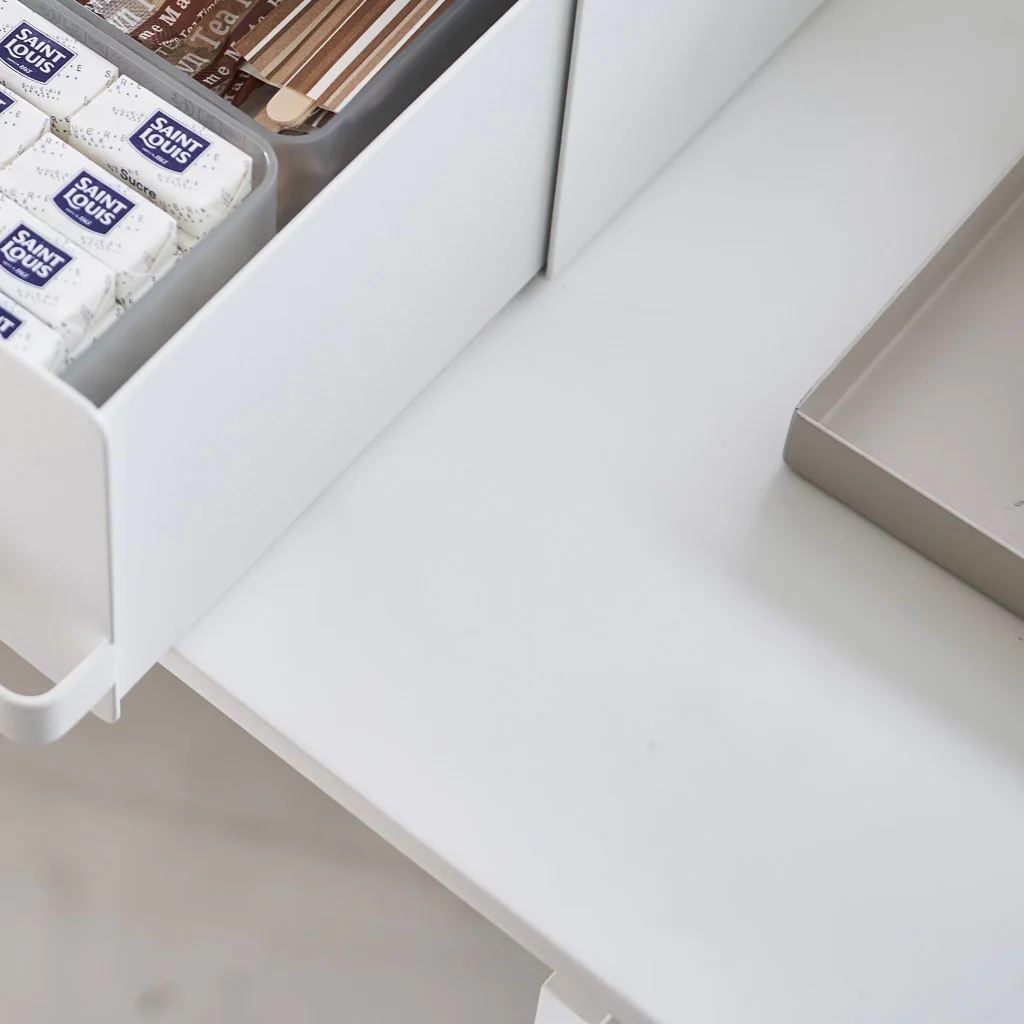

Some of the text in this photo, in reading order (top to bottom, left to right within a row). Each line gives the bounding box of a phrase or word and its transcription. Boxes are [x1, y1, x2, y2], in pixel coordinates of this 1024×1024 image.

[15, 27, 67, 64] SAINT
[189, 9, 241, 51] Tea
[4, 37, 56, 74] LOUIS
[138, 127, 192, 164] LOUIS
[149, 115, 204, 154] SAINT
[74, 176, 129, 215] SAINT
[119, 167, 157, 200] Sucre
[62, 186, 117, 226] LOUIS
[0, 239, 54, 280] LOUIS
[11, 228, 66, 269] SAINT
